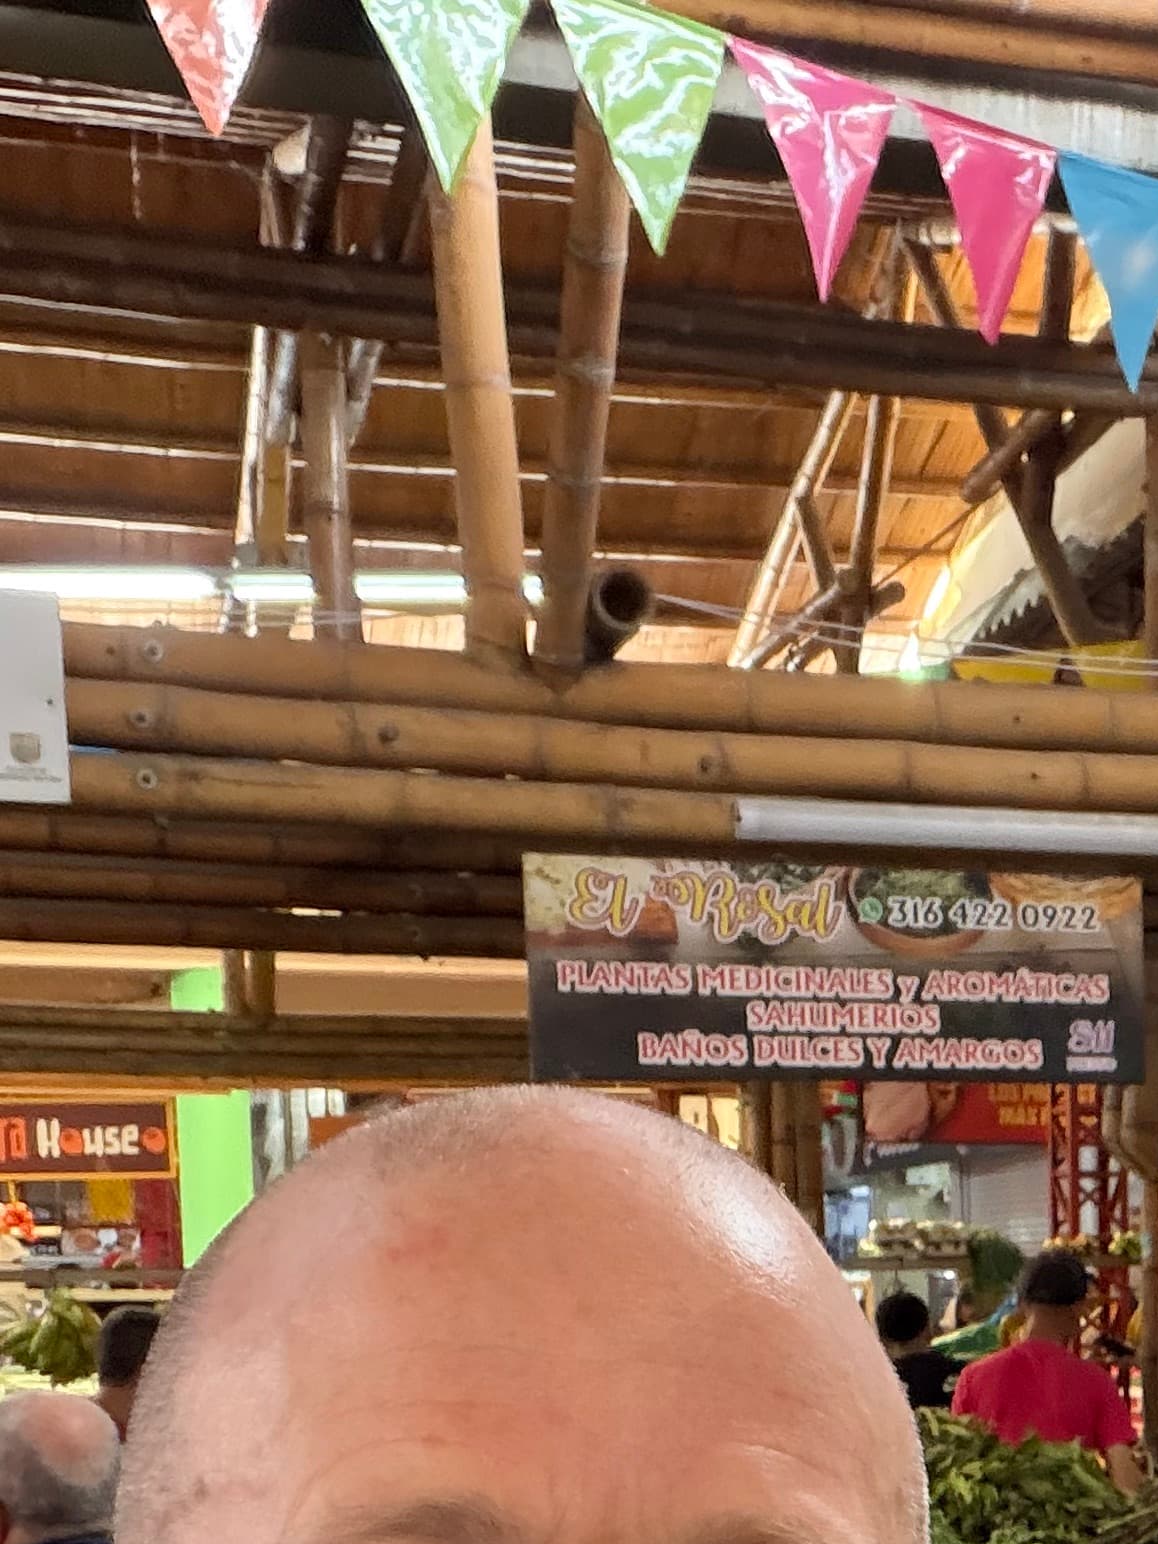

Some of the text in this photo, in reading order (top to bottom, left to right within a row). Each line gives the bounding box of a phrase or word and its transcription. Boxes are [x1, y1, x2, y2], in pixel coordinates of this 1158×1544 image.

[570, 867, 843, 943] El Rosal
[889, 898, 1099, 931] 316 422 0922
[558, 962, 690, 994] PLANTAS
[698, 966, 894, 998] MEDICINALES
[922, 968, 1109, 1002] AROMÁTICAS
[748, 1001, 940, 1033] SAHUMERIOS
[638, 1030, 747, 1064] BAÑOS
[754, 1035, 863, 1066] DULCES
[867, 1037, 890, 1067] Y
[894, 1039, 1042, 1069] AMARGOS
